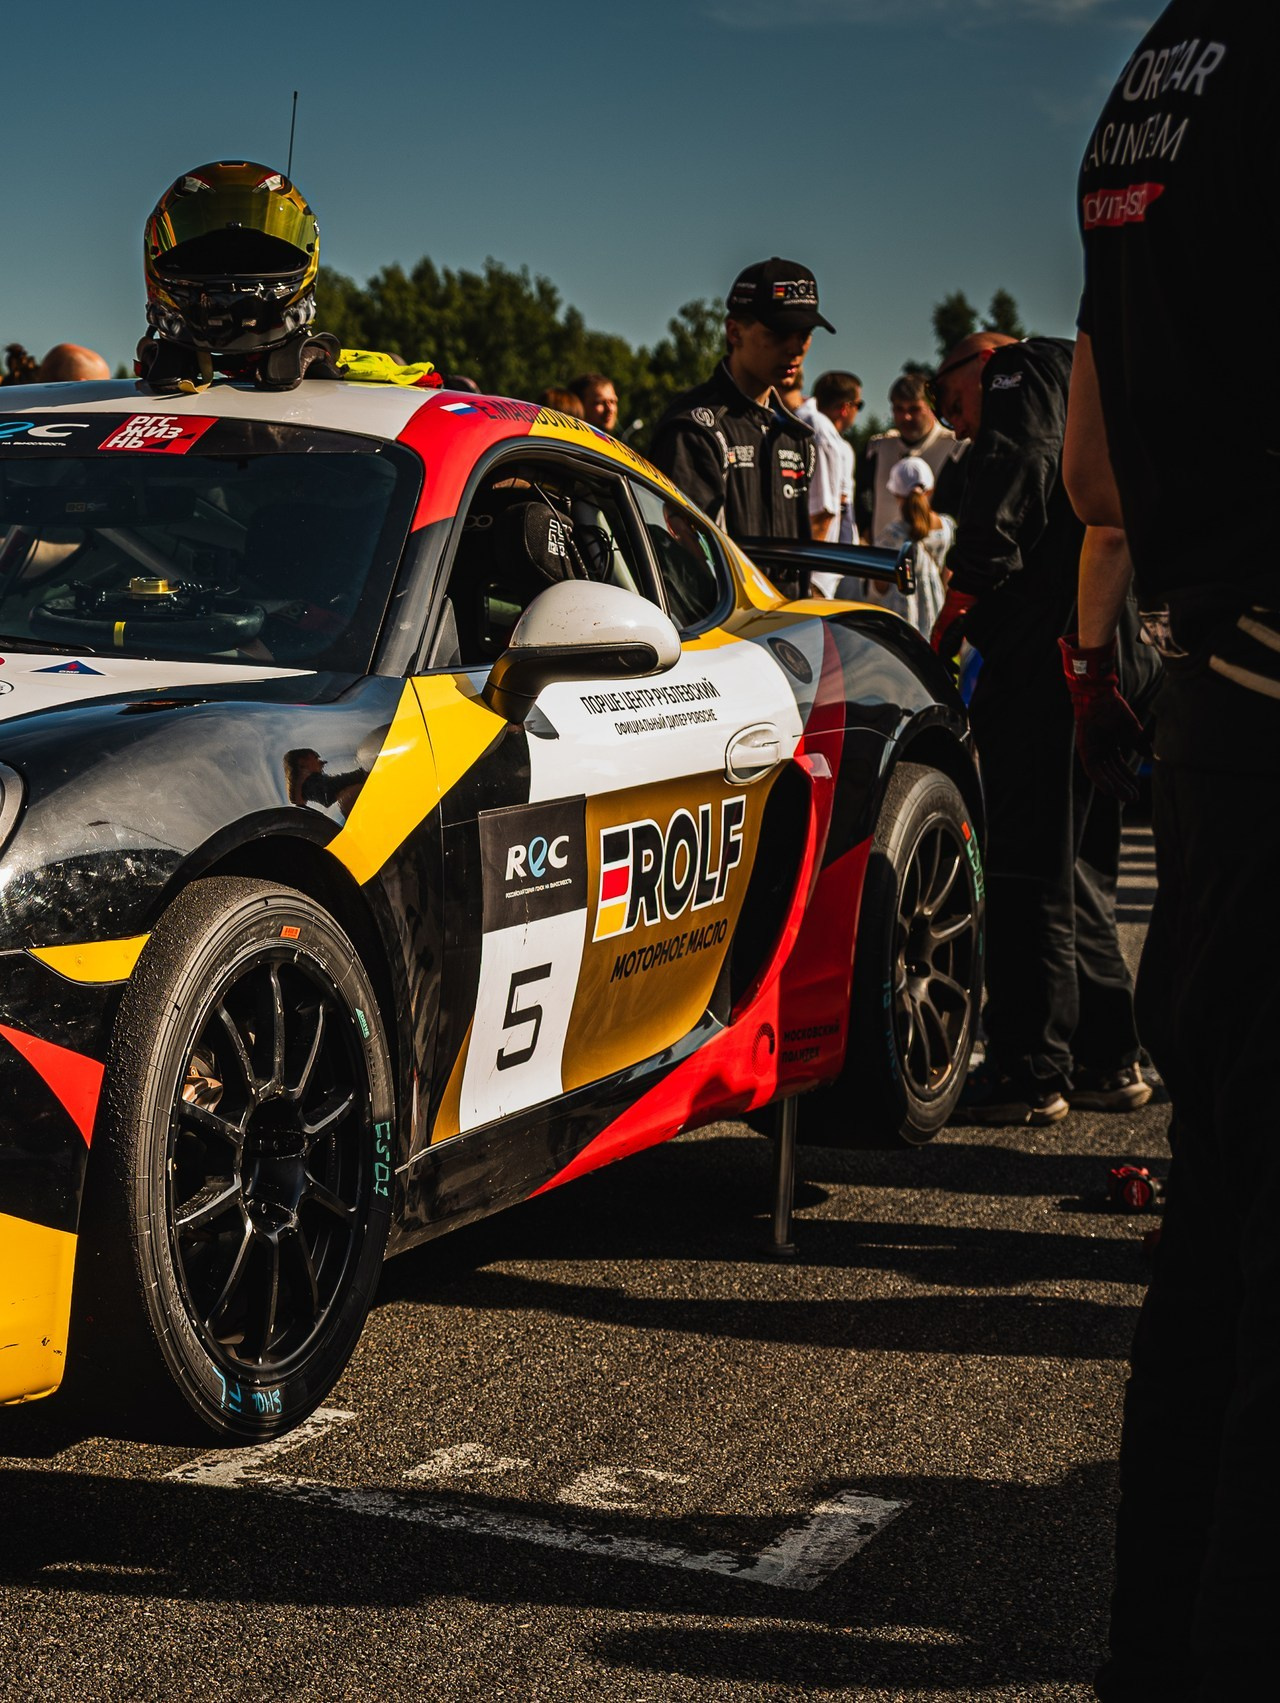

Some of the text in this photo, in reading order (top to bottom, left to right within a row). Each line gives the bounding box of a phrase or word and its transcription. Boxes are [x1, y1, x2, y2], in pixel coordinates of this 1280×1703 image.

[117, 425, 183, 439] ЖИЗ
[128, 416, 178, 427] РГС
[106, 436, 145, 448] НЬ
[580, 677, 721, 714] ПОРШЕ ЦЕНТР РУБЛЕВСКИЙ
[687, 708, 718, 725] PORSCHE
[625, 795, 747, 930] ROLF
[610, 918, 728, 983] МОТОРНОЕ МАСЛО
[496, 962, 553, 1072] 5
